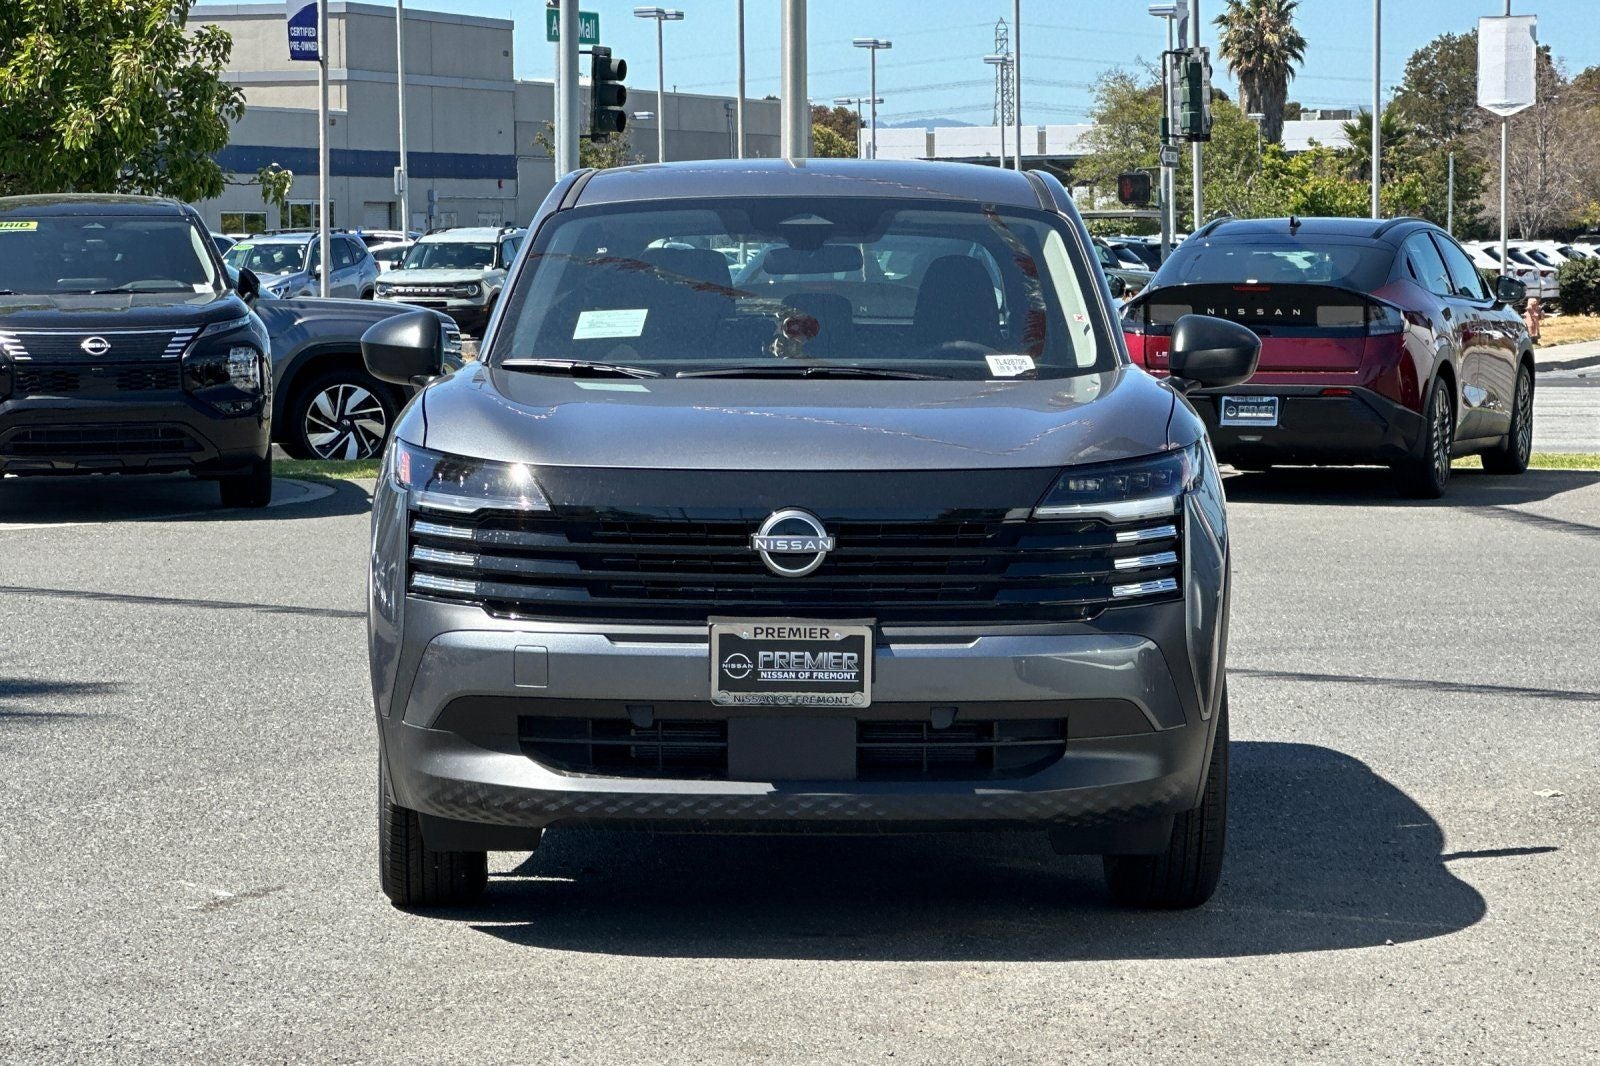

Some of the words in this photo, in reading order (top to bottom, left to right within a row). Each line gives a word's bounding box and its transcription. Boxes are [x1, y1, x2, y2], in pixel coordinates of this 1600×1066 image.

[290, 27, 317, 37] CERTIFIED
[578, 18, 596, 39] Mall
[290, 41, 319, 51] PRE-OWNED
[1207, 308, 1301, 316] NISSAN
[755, 539, 831, 550] NISSAN
[753, 626, 830, 639] PREMIER
[758, 651, 859, 670] PREMIER
[760, 671, 796, 679] NISSAN
[798, 671, 811, 680] OF
[813, 672, 857, 680] FREMONT
[733, 695, 773, 704] NISSAN
[796, 695, 850, 705] FREMONT
